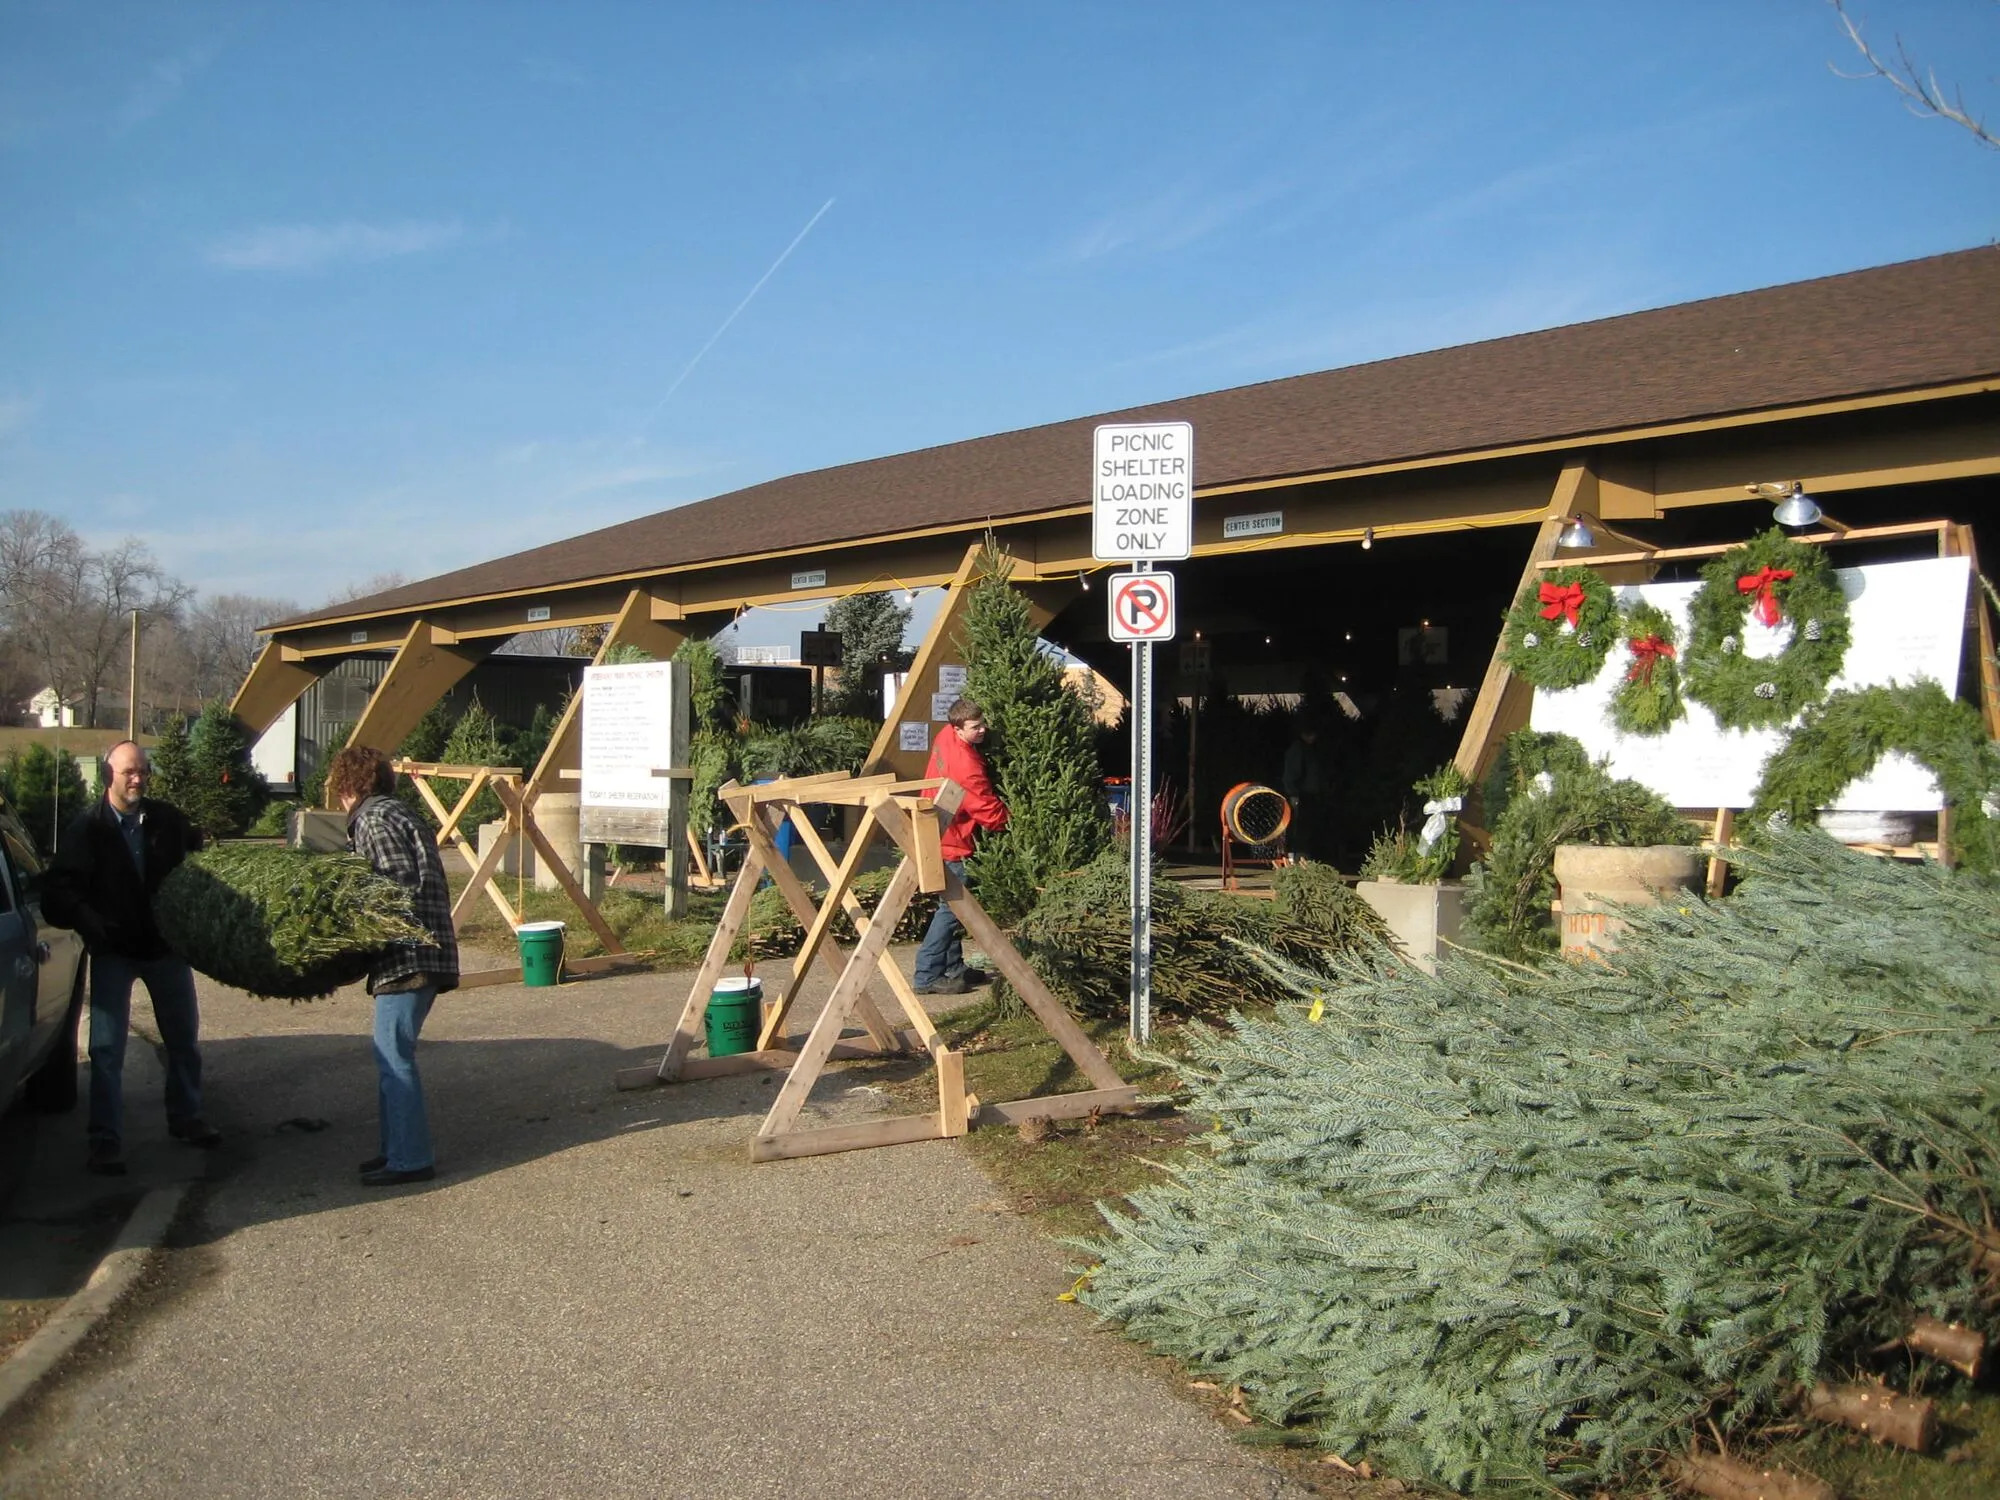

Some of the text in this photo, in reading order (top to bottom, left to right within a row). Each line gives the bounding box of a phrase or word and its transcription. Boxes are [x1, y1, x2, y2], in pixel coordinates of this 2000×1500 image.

[1111, 433, 1174, 452] PICNIC
[1101, 457, 1185, 477] SHELTER
[1100, 482, 1185, 501] LOADING
[1116, 507, 1168, 525] ZONE
[1226, 517, 1280, 532] CENTER SECTION
[1116, 532, 1167, 550] ONLY
[1569, 914, 1607, 934] HOT
